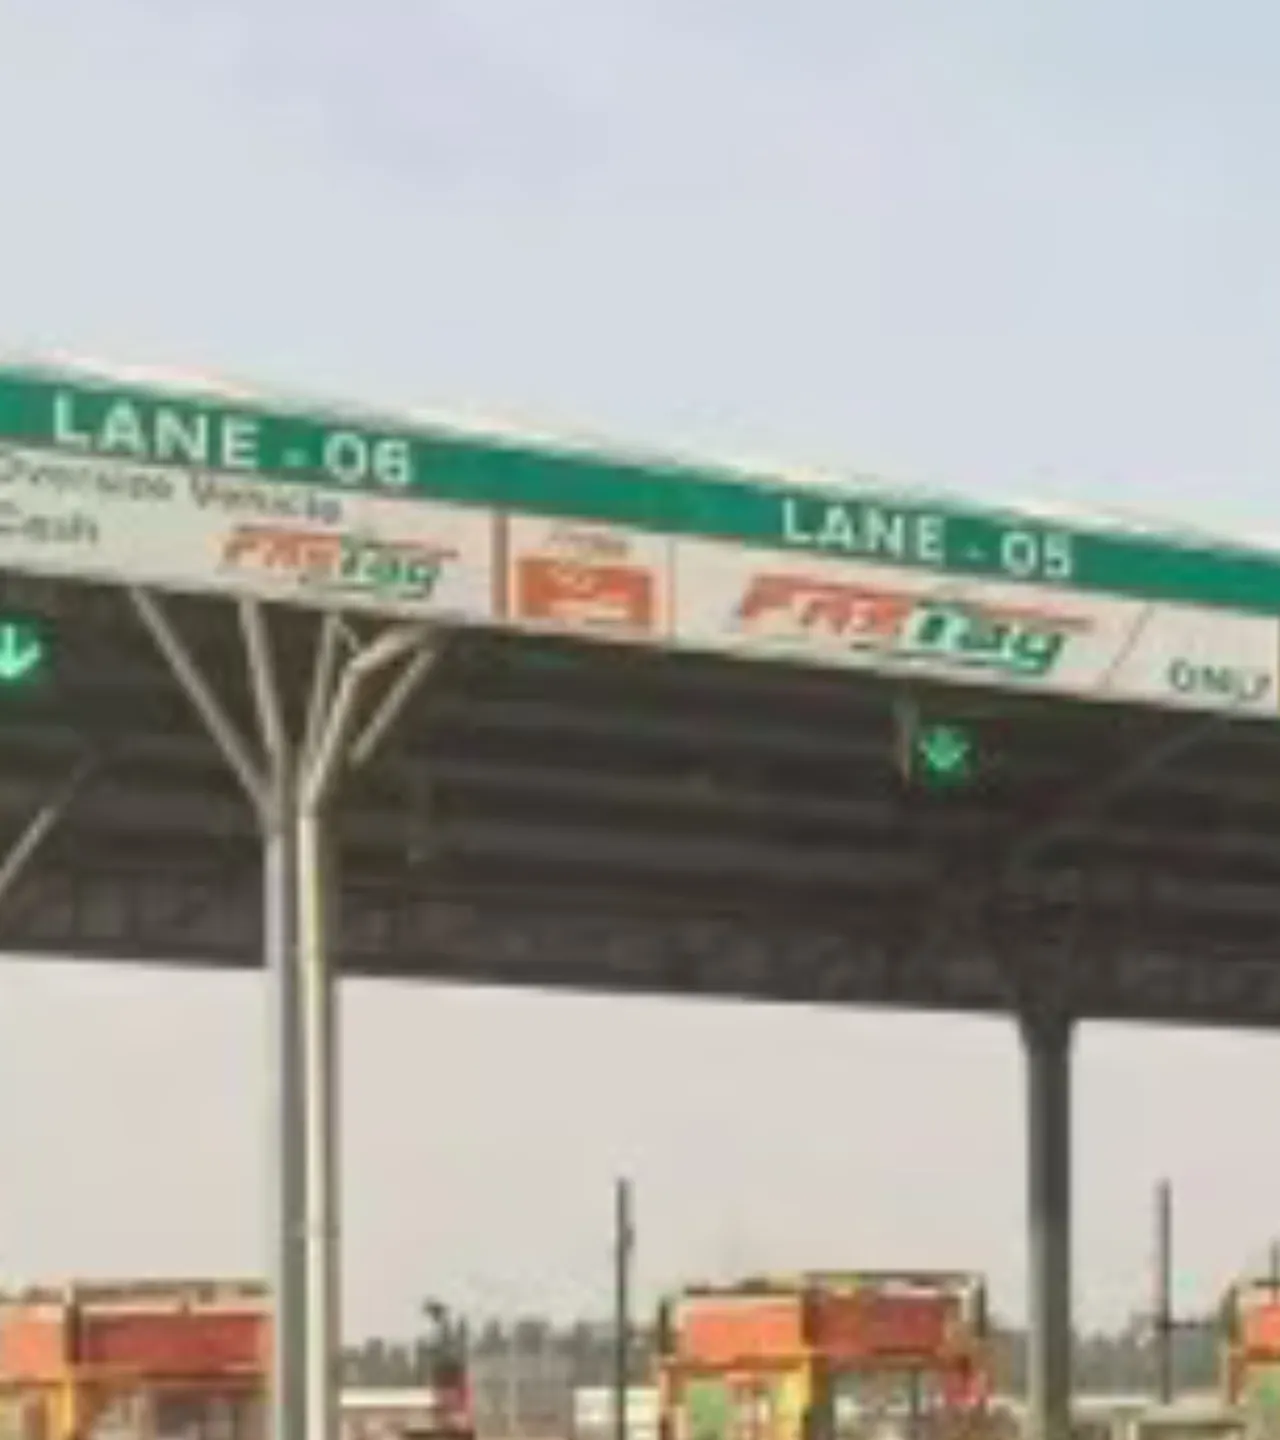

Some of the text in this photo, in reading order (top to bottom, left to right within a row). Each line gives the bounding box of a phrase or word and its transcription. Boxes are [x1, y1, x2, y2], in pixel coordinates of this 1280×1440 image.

[52, 393, 259, 469] LANE
[321, 431, 414, 487] 06
[783, 497, 947, 560] LANE
[1001, 528, 1073, 579] 05
[1167, 658, 1272, 700] ONLY
